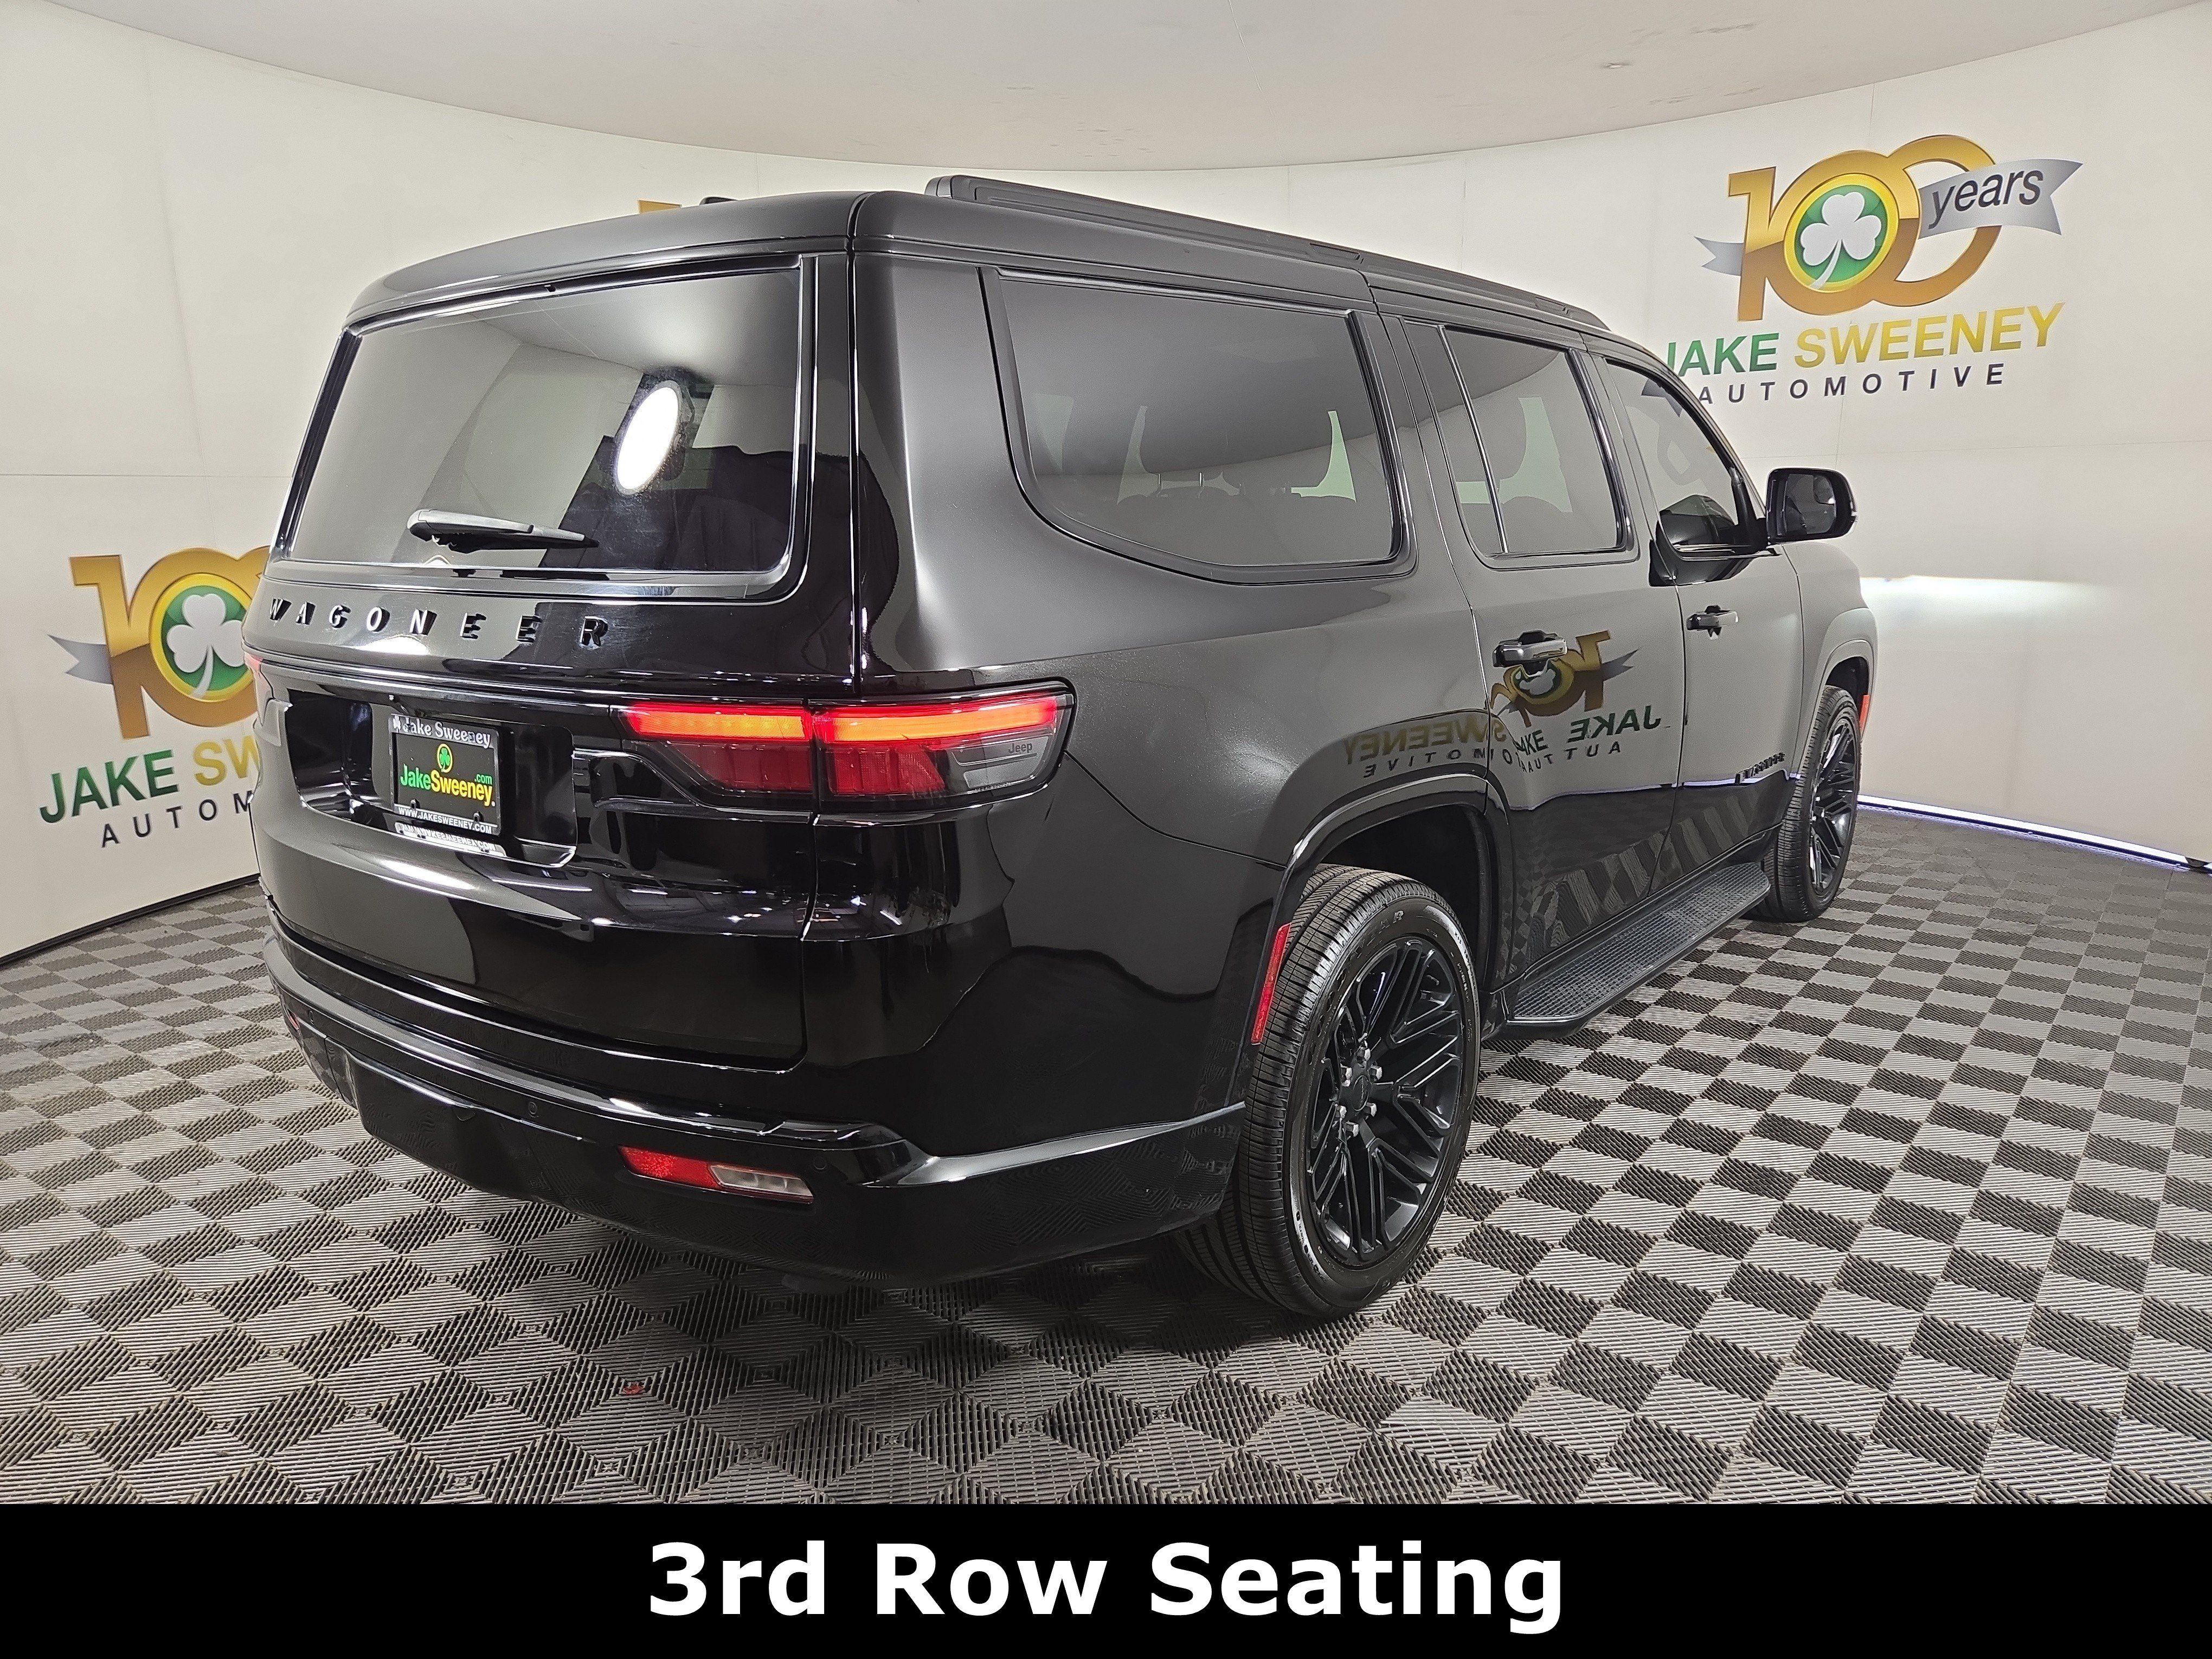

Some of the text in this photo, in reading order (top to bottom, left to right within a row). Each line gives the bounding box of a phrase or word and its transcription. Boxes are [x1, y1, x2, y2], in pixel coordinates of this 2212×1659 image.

[1928, 169, 2044, 229] years
[1794, 302, 2065, 368] SWEENEY
[1699, 363, 2004, 404] AUTOMOTIVE
[269, 597, 609, 648] WAGONEER
[403, 717, 491, 749] Jake Sweeney
[1008, 742, 1033, 754] Jeep
[39, 749, 179, 824] JAKE
[398, 807, 492, 834] WWW.JAKESWEENEY.COM
